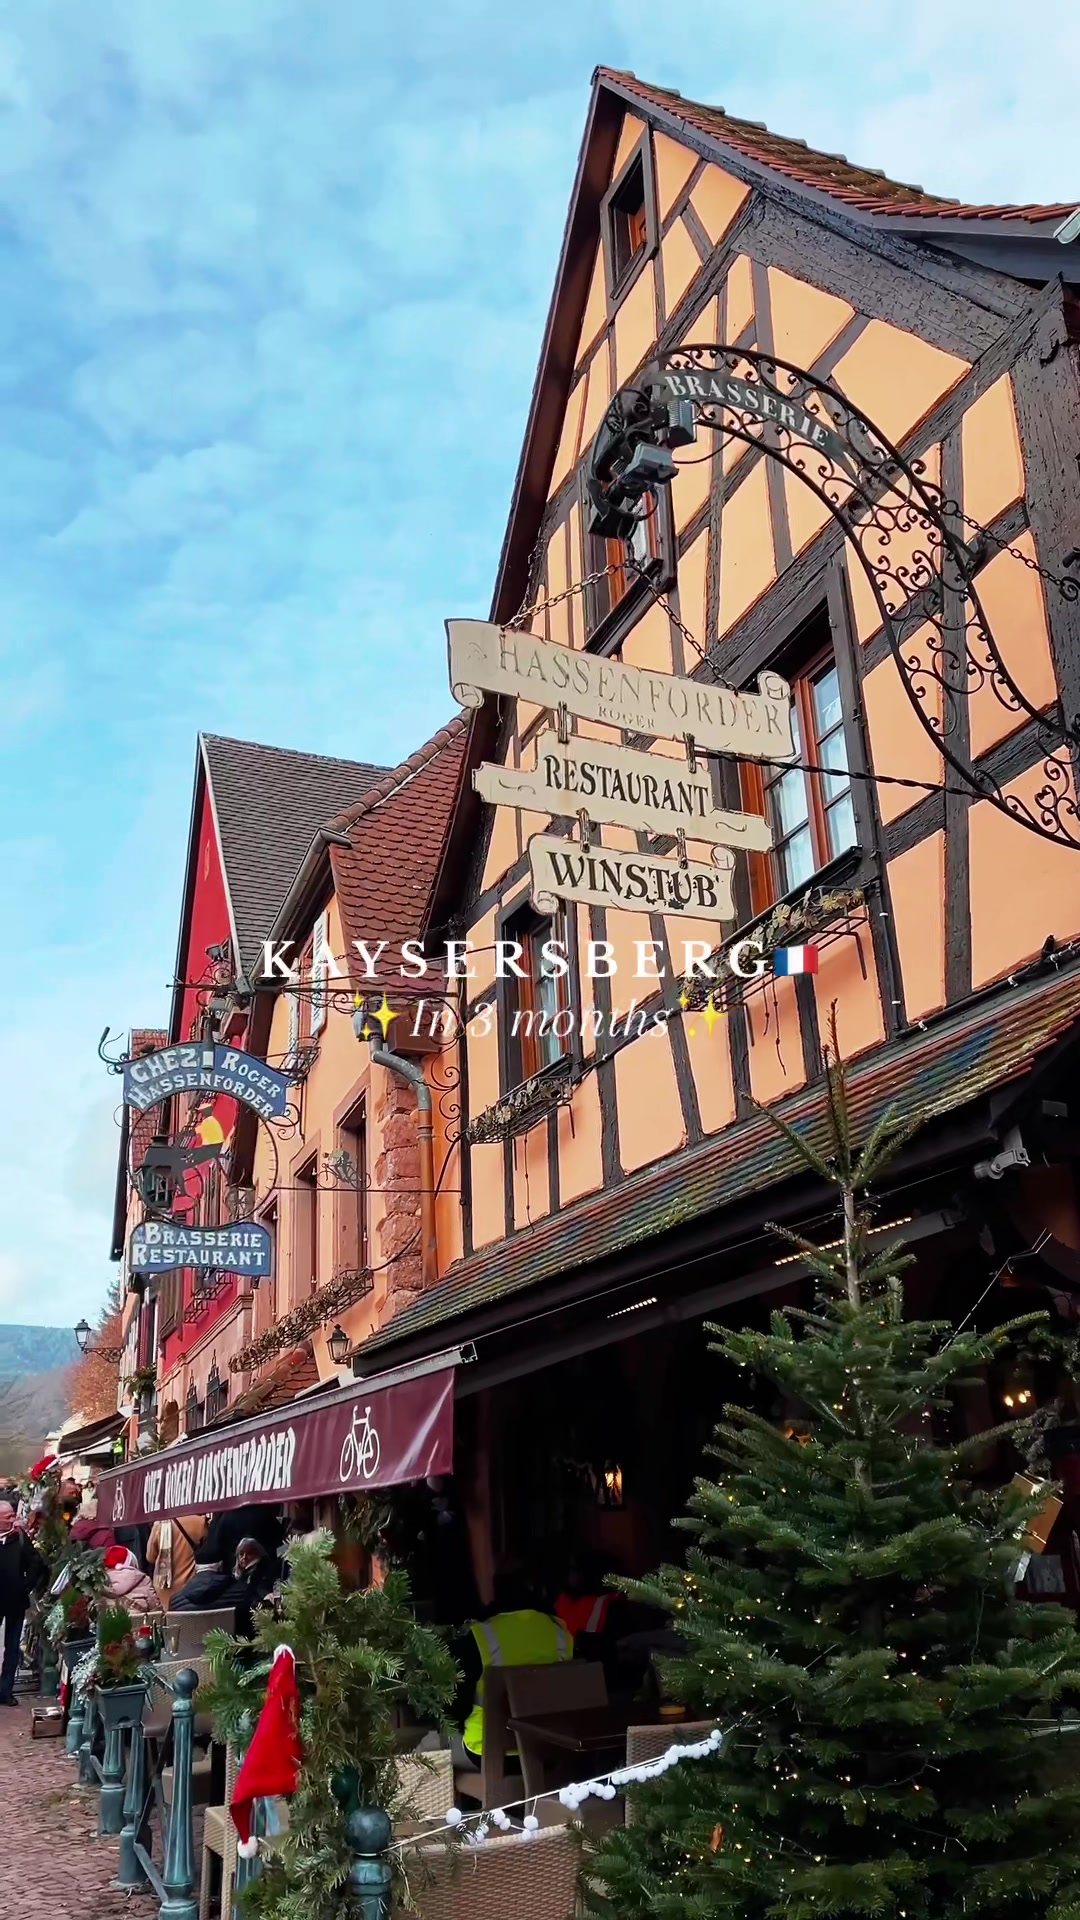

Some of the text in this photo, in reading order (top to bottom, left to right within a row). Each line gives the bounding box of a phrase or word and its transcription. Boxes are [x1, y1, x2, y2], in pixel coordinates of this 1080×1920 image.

[665, 374, 830, 447] BRASSERIE
[498, 633, 784, 736] HASSENFORDER
[544, 755, 709, 818] RESTAURANT
[546, 851, 718, 909] WINSTUB
[127, 1072, 276, 1118] HASSENFORDER
[130, 1048, 283, 1099] CHEZ ROGER
[131, 1243, 266, 1266] RESTAURANT
[144, 1222, 263, 1248] BRASSERIE
